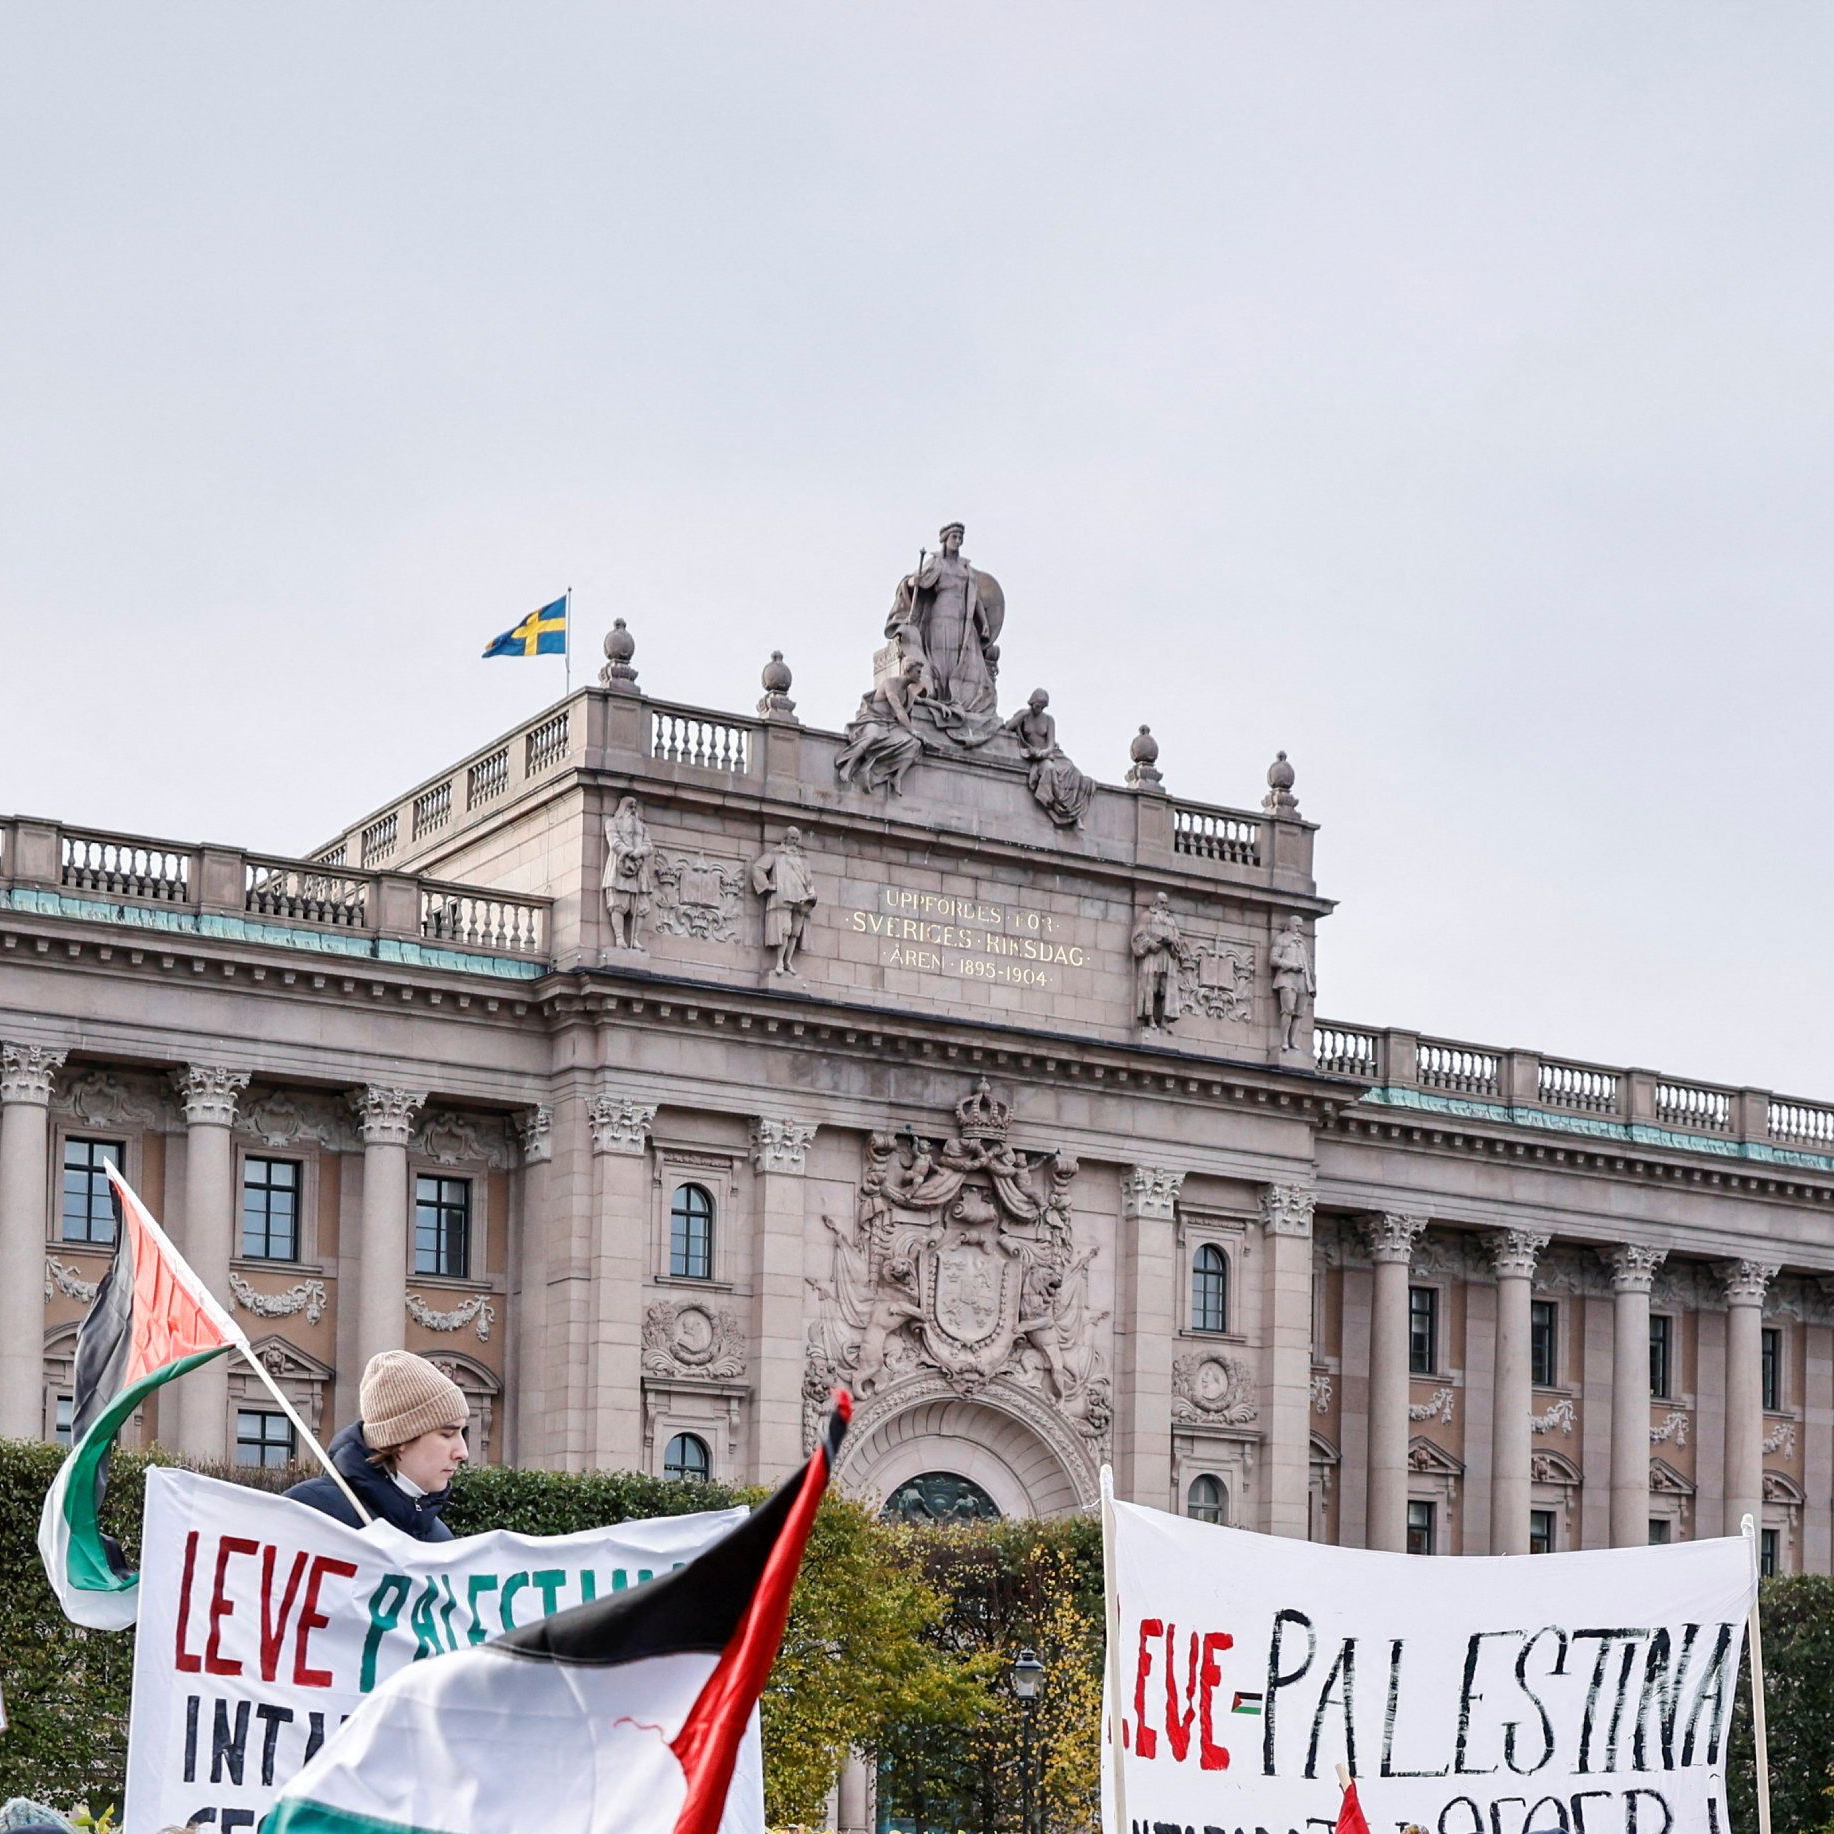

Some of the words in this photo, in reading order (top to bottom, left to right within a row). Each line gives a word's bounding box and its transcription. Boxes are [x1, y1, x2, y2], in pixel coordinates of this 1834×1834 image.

[853, 911, 971, 949] SVERIGES
[986, 933, 1083, 967] RIKSDAG
[890, 944, 944, 969] ÅREN
[960, 959, 1047, 987] 1895-1904
[175, 1531, 358, 1687] LEVE
[359, 1563, 694, 1693] PALEST
[1111, 1600, 1234, 1771] EVE
[1261, 1608, 1740, 1778] PALESTINA
